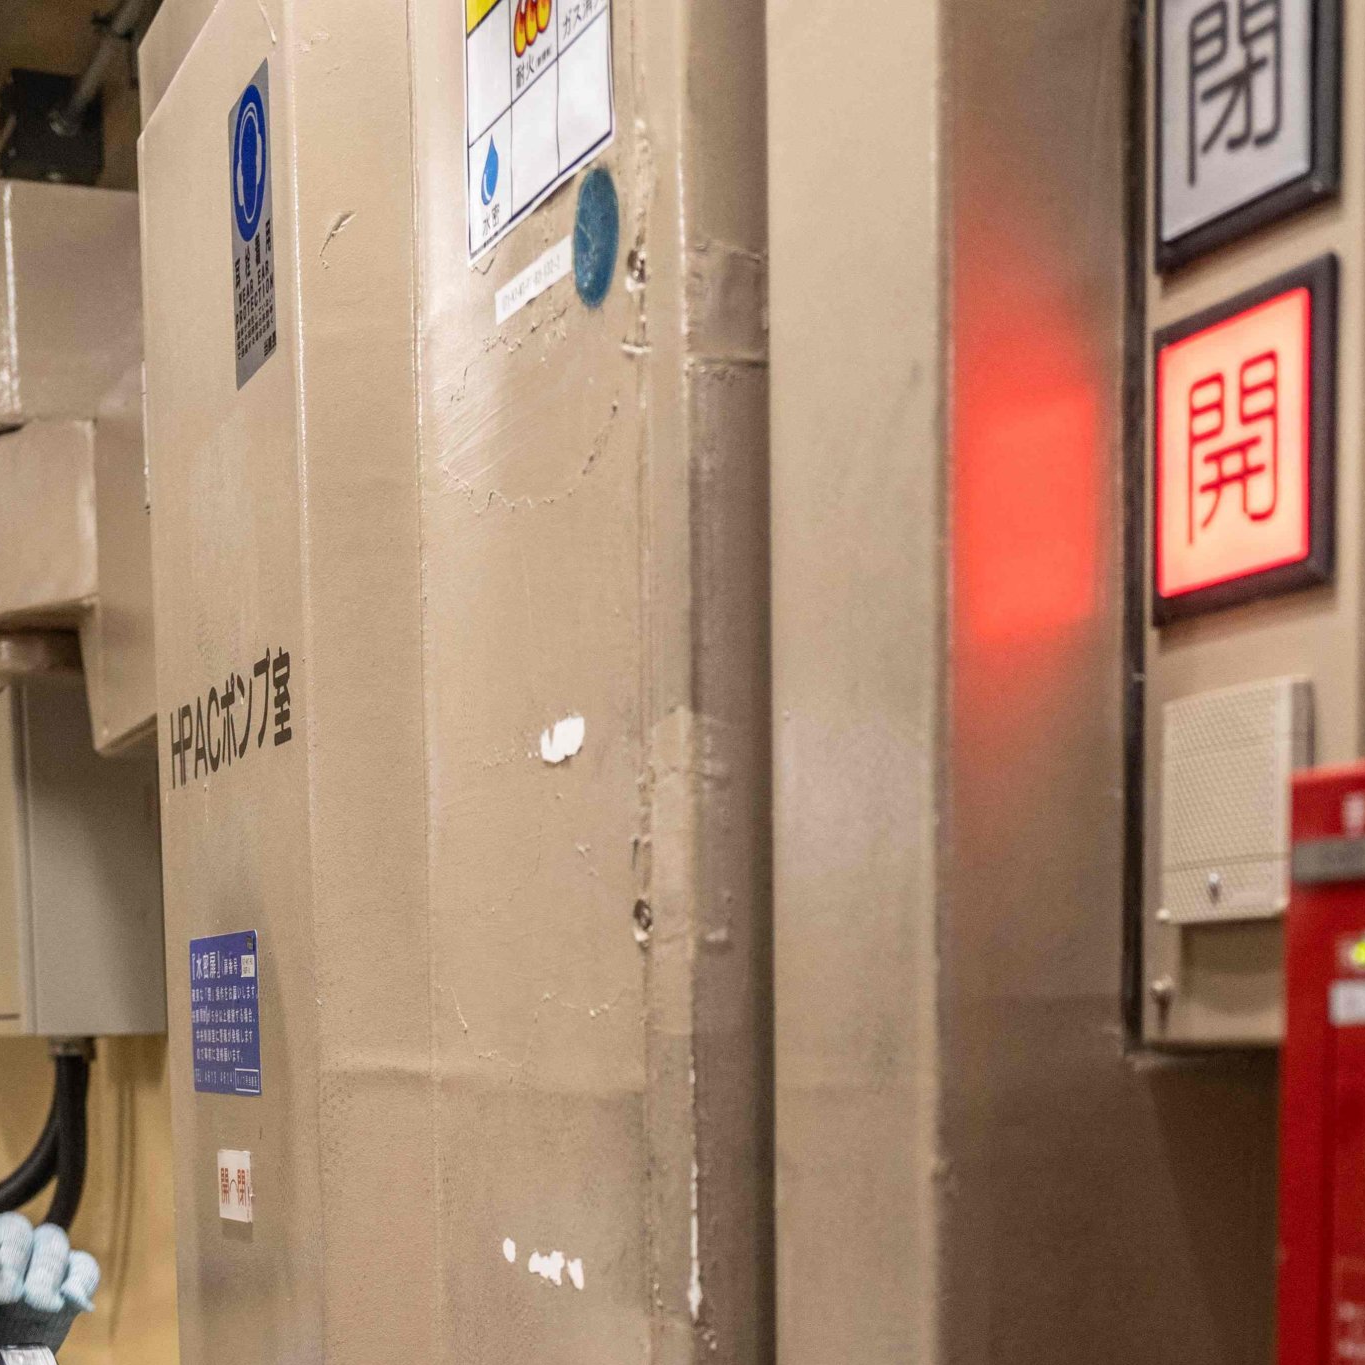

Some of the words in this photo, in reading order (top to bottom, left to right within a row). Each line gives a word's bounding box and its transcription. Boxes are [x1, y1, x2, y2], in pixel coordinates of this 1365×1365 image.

[1189, 0, 1283, 187] 閉
[1189, 350, 1278, 548] 開
[170, 646, 292, 790] HPACポンプ室
